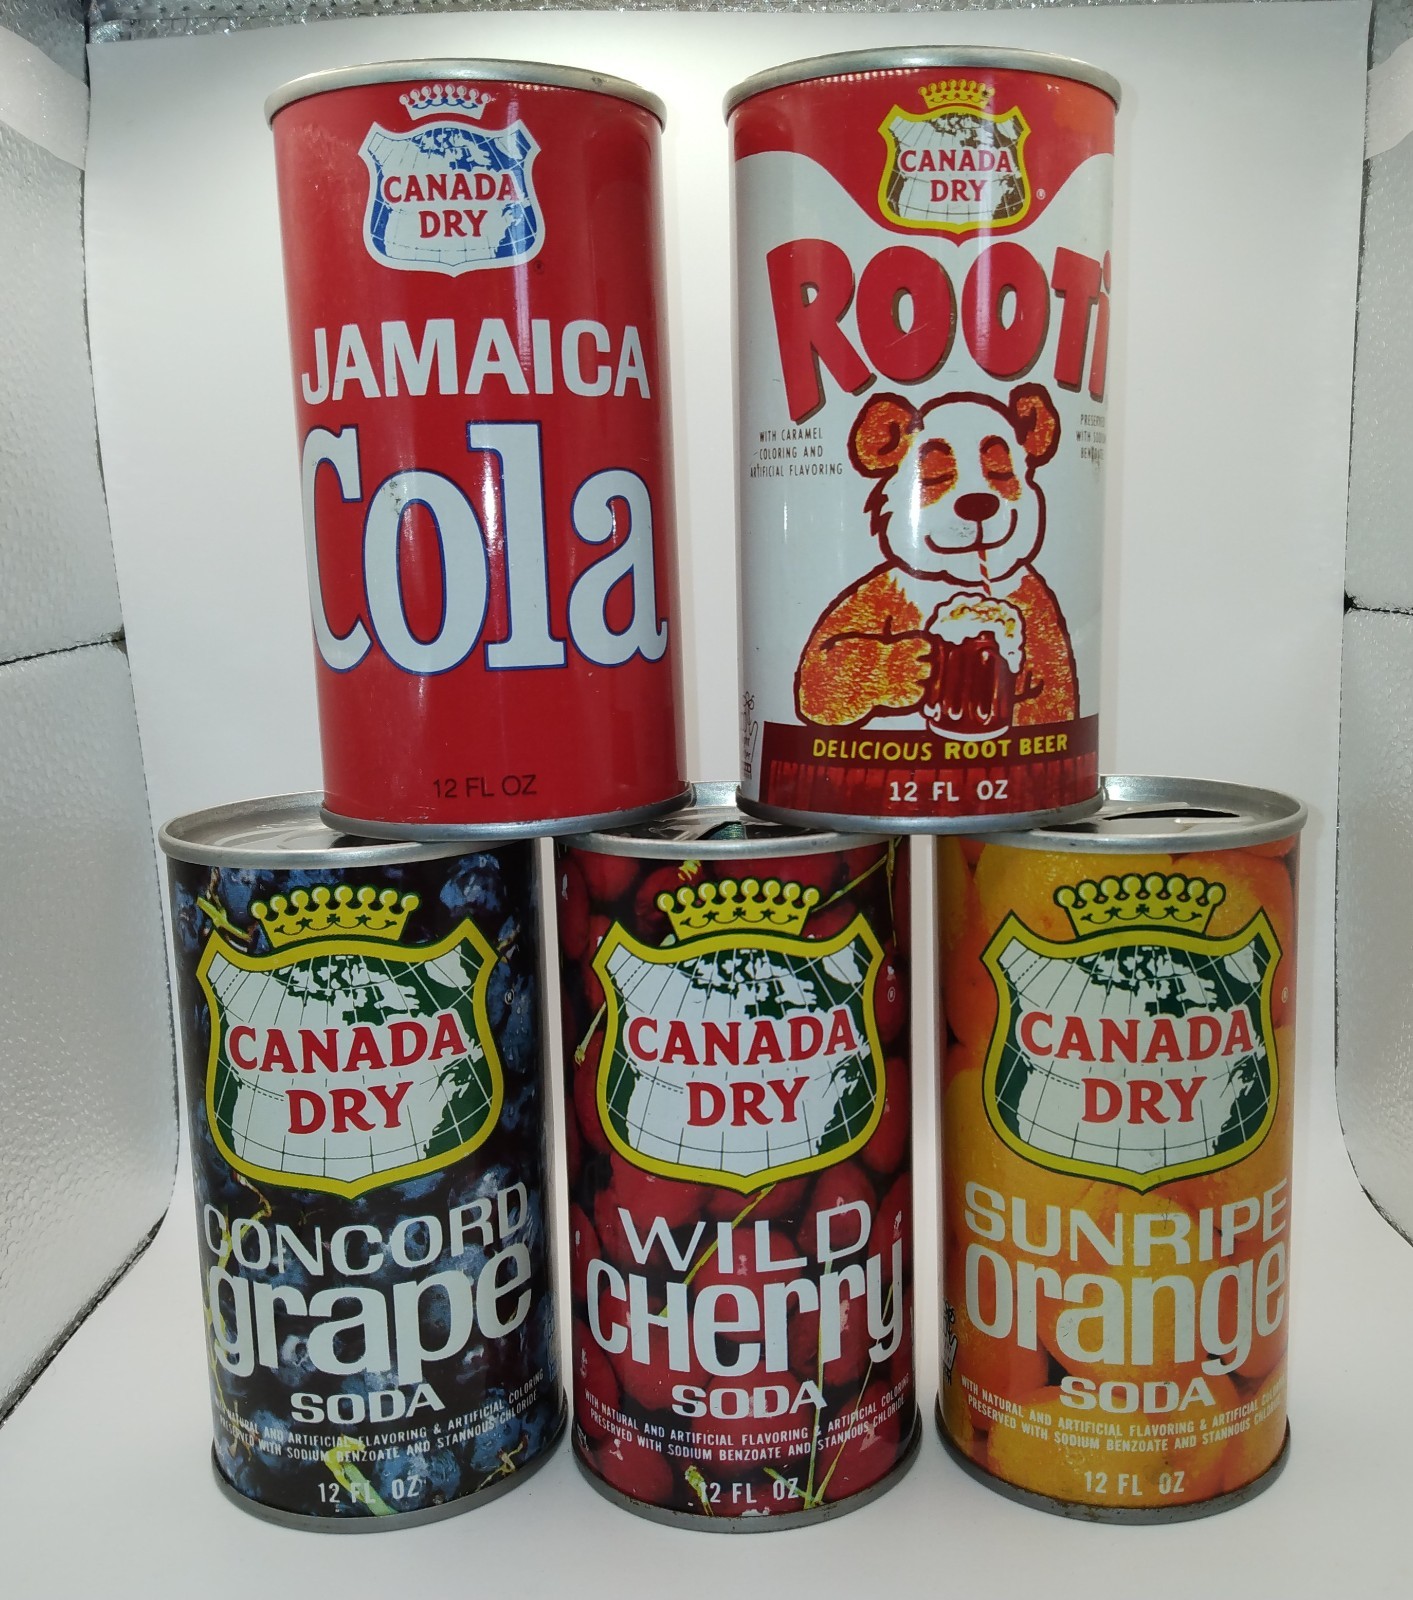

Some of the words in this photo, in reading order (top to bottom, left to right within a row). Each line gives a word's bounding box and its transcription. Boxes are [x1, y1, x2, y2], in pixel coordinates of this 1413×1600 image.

[901, 149, 1012, 173] CANADA
[384, 173, 514, 202] CANADA
[930, 179, 987, 202] DRY
[419, 210, 488, 238] DRY
[301, 318, 651, 405] JAMAICA
[759, 430, 777, 442] WITH
[781, 427, 824, 441] CARAMEL
[759, 446, 798, 460] COLORING
[803, 445, 824, 458] AND
[750, 463, 785, 478] ARTIFICIAL
[789, 463, 843, 476] FLAVORING
[301, 420, 668, 677] Cola
[812, 737, 932, 761] DELICIOUS
[944, 739, 1011, 759] ROOT
[1019, 733, 1068, 756] BEER
[433, 779, 457, 798] 12
[466, 776, 495, 798] FL
[502, 774, 537, 795] OZ
[889, 782, 917, 802] 12
[933, 782, 959, 801] FL
[976, 779, 1008, 800] OZ
[228, 1013, 467, 1074] CANADA
[628, 1008, 857, 1066] CANADA
[1020, 1009, 1254, 1064] CANADA
[285, 1081, 414, 1135] DRY
[686, 1076, 810, 1127] DRY
[1081, 1075, 1207, 1124] DRY
[203, 1181, 528, 1276] CONCORD
[617, 1199, 872, 1274] WILD
[965, 1178, 1287, 1267] SUNRIPE
[208, 1242, 532, 1390] grape
[263, 1427, 284, 1443] AND
[288, 1433, 348, 1447] ARTIFICIAL
[360, 1426, 427, 1447] FLAVORING
[433, 1422, 442, 1435] &
[447, 1399, 505, 1431] ARTIFICIAL
[508, 1368, 544, 1404] COLORING
[290, 1383, 446, 1424] SODA
[584, 1388, 599, 1409] WITH
[601, 1403, 639, 1431] NATURAL
[643, 1423, 665, 1438] AND
[670, 1429, 734, 1446] ARTIFICIAL
[741, 1427, 808, 1446] FLAVORING
[828, 1406, 878, 1432] ARTIFICIAL
[671, 1380, 828, 1419] SODA
[961, 1374, 979, 1396] WITH
[982, 1389, 1024, 1418] NATURAL
[1029, 1410, 1052, 1426] AND
[1058, 1417, 1123, 1436] ARTIFICIAL
[1129, 1420, 1195, 1437] FLAVORING
[1199, 1419, 1207, 1431] &
[1212, 1402, 1259, 1428] ARTIFICIAL
[1059, 1376, 1216, 1414] SODA
[258, 1438, 282, 1456] WITH
[286, 1447, 329, 1462] SODIUM
[336, 1448, 400, 1462] BENZOATE
[406, 1440, 431, 1456] AND
[437, 1417, 495, 1449] STANNOUS
[500, 1389, 537, 1425] CHLORIDE
[590, 1408, 632, 1442] PRESERVED
[637, 1434, 662, 1453] WITH
[667, 1443, 712, 1461] SODIUM
[719, 1447, 781, 1461] BENZOATE
[788, 1442, 811, 1456] AND
[817, 1420, 869, 1451] STANNOUS
[872, 1394, 905, 1427] CHLORIDE
[968, 1394, 1017, 1429] PRESERVED
[1021, 1422, 1048, 1441] WITH
[1054, 1431, 1100, 1450] SODIUM
[1106, 1438, 1169, 1452] BENZOATE
[1174, 1436, 1197, 1450] AND
[1202, 1417, 1251, 1445] STANNOUS
[318, 1482, 340, 1503] 12
[350, 1480, 376, 1504] FL
[391, 1474, 421, 1500] OZ
[732, 1483, 757, 1504] FL
[772, 1477, 799, 1501] OZ
[1084, 1471, 1108, 1494] 12
[1118, 1473, 1143, 1496] FL
[1158, 1471, 1185, 1495] OZ
